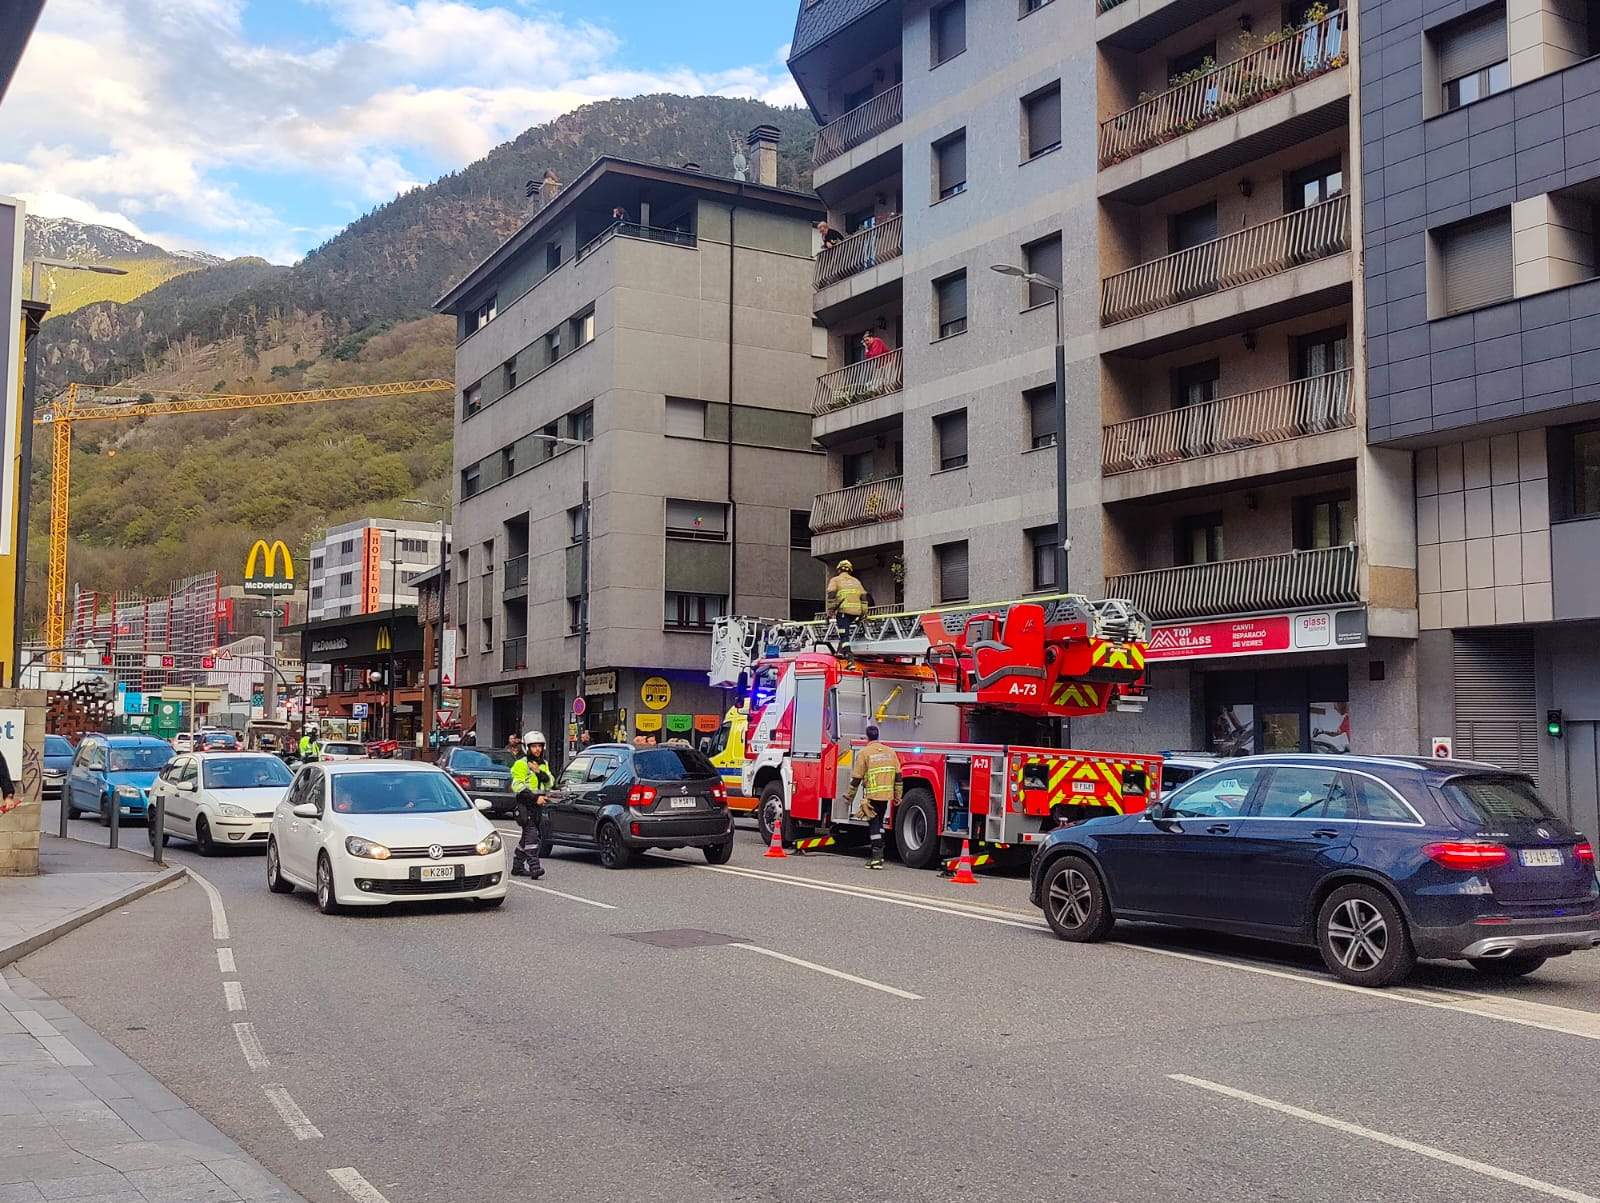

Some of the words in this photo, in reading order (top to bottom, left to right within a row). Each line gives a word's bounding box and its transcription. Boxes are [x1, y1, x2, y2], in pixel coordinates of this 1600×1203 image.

[371, 536, 379, 581] HOTEL
[1303, 617, 1327, 629] glass
[1173, 628, 1192, 637] TOP
[1232, 629, 1267, 640] REPARACIÓ
[1178, 635, 1212, 647] GLASS
[1241, 639, 1264, 647] VIDRES
[1009, 682, 1037, 695] A-73
[974, 759, 989, 769] A-73
[430, 867, 453, 877] K2807
